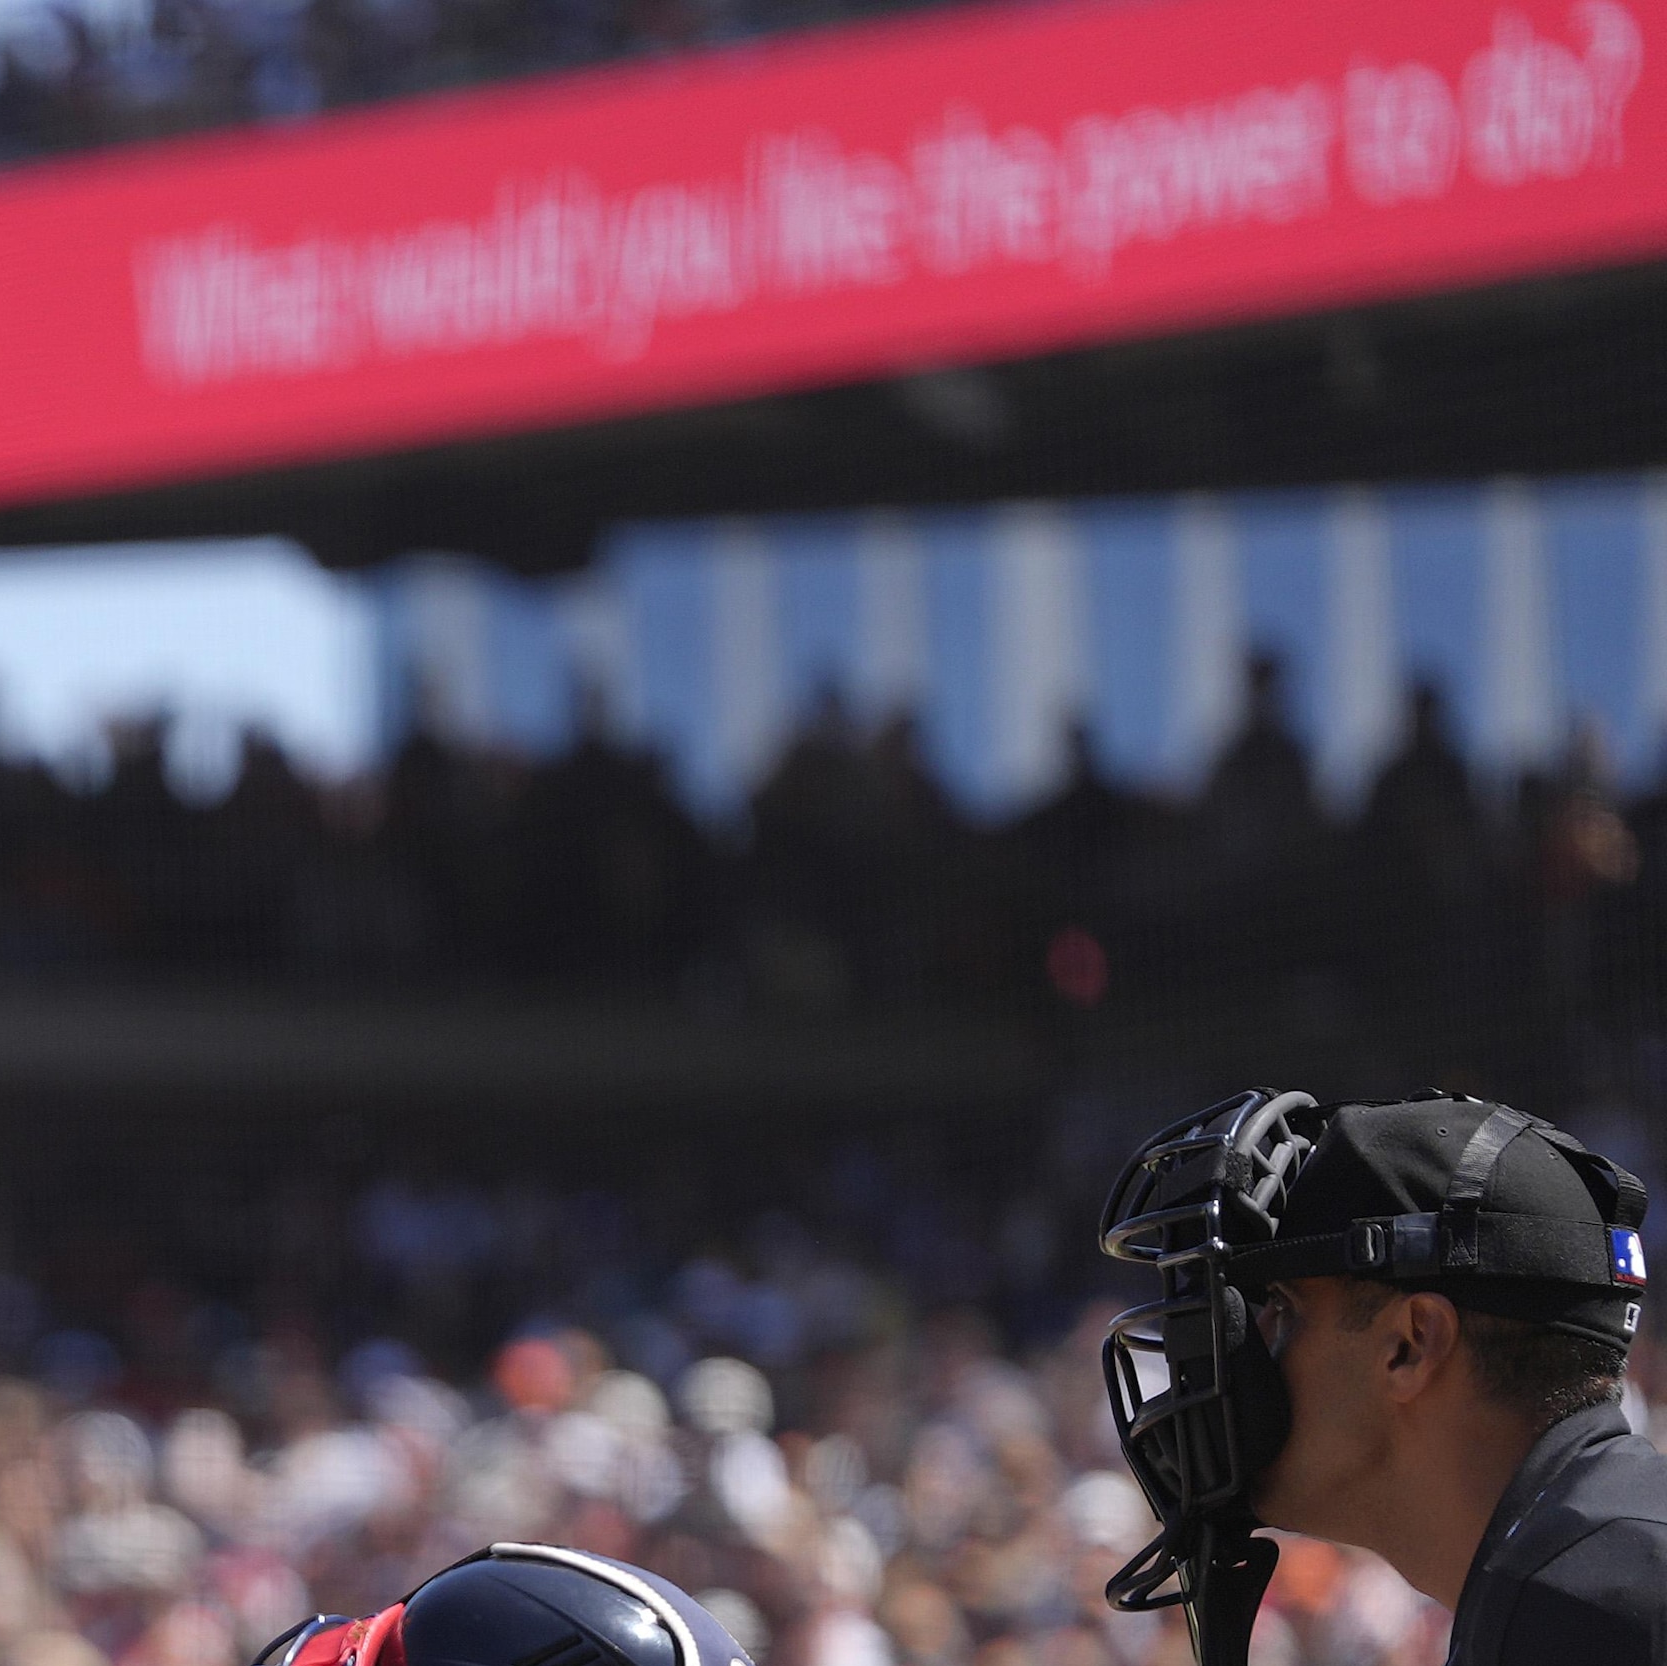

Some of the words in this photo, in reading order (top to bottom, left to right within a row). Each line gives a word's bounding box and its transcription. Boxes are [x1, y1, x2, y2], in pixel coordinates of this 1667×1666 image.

[914, 102, 1060, 274] the
[1063, 80, 1329, 288] power
[1345, 54, 1457, 204] to
